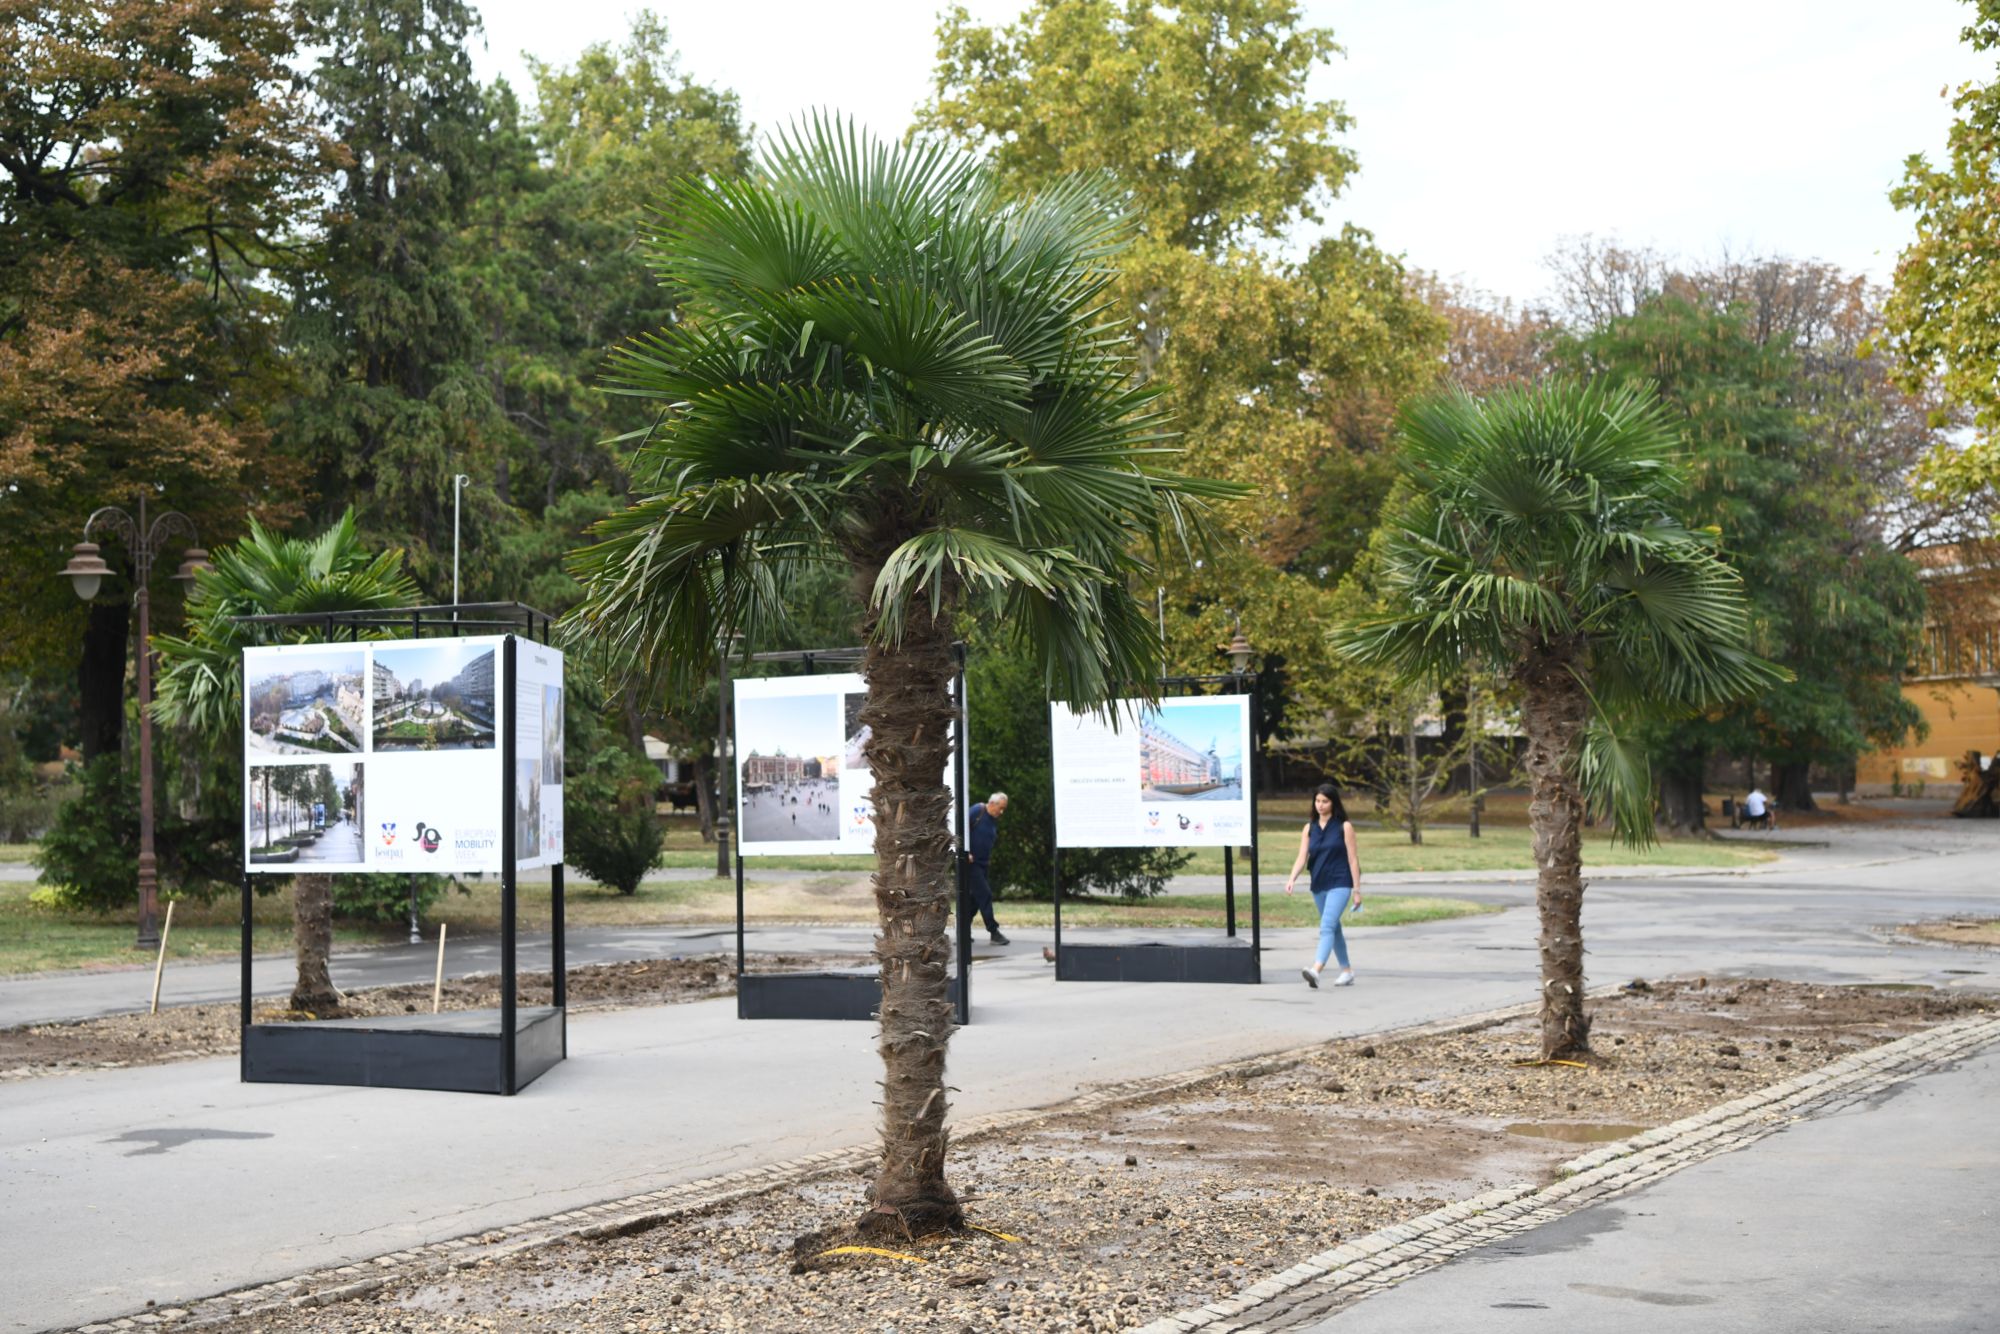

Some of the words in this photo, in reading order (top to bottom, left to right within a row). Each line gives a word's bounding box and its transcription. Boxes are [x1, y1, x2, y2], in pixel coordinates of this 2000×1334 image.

[455, 829, 497, 838] EUROPEAN
[455, 840, 495, 849] MOBILITY
[455, 850, 477, 859] WEEK
